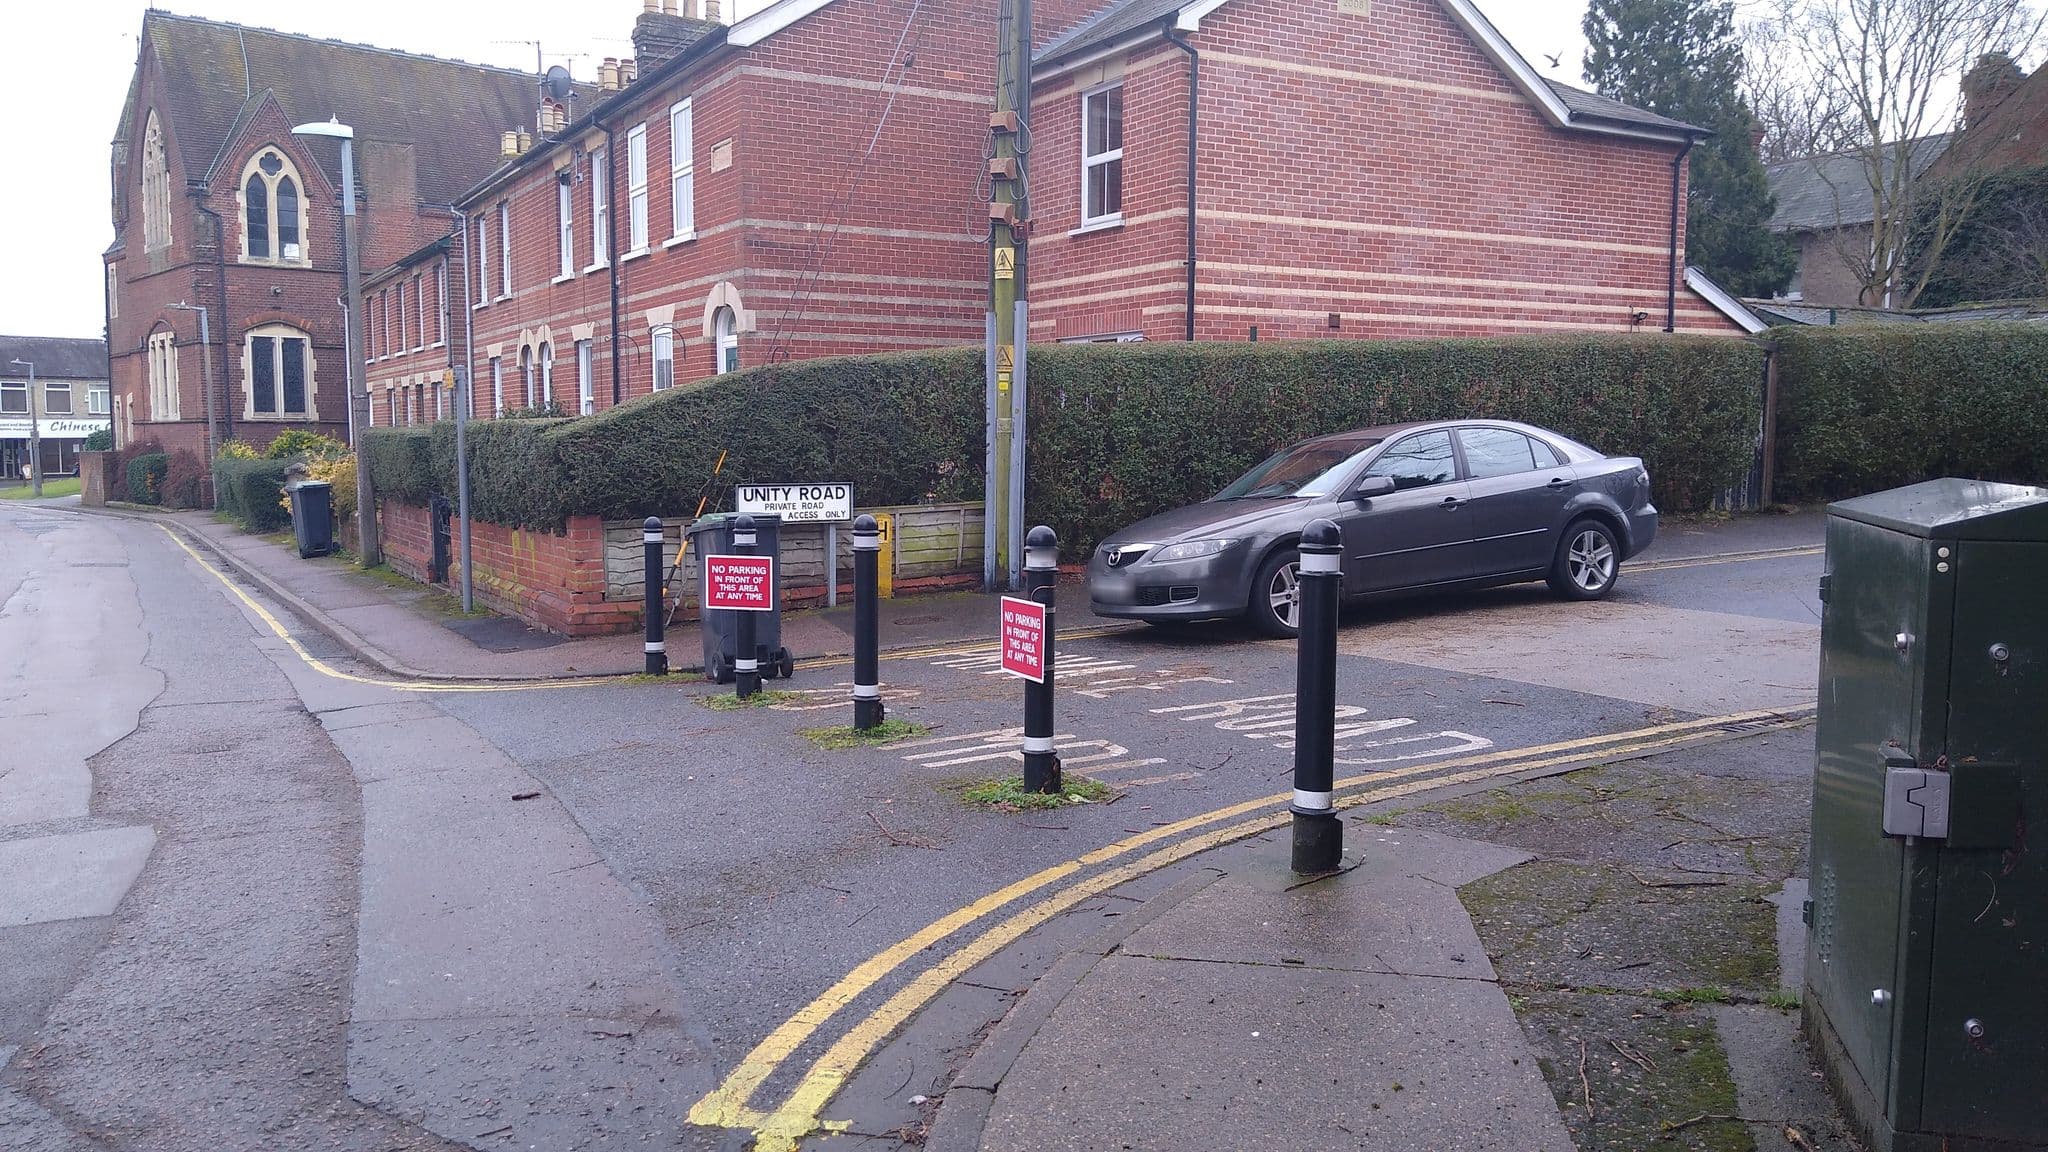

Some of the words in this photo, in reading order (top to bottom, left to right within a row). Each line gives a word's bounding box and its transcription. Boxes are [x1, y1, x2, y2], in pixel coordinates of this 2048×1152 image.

[50, 421, 100, 431] Chinese
[743, 487, 792, 502] UNITY
[799, 486, 846, 501] ROAD
[764, 503, 797, 511] PRIVATE
[801, 502, 824, 510] ROAD
[788, 511, 818, 520] ACCESS
[826, 510, 846, 518] ONLY
[711, 565, 725, 574] NO
[728, 566, 767, 575] PARKING
[719, 584, 736, 592] THIS
[739, 585, 759, 593] AREA
[727, 592, 743, 600] ANY
[745, 593, 763, 601] TIME
[1004, 611, 1014, 623] NO
[1015, 613, 1041, 629] PARKING
[1007, 625, 1012, 636] IN
[1013, 627, 1030, 639] FRONT
[1031, 632, 1039, 642] OF
[1009, 638, 1020, 649] THIS
[1022, 642, 1036, 654] AREA
[1007, 650, 1013, 659] AT
[1014, 652, 1025, 663] ANY
[1026, 654, 1038, 667] TIME
[1149, 692, 1494, 765] ROAD
